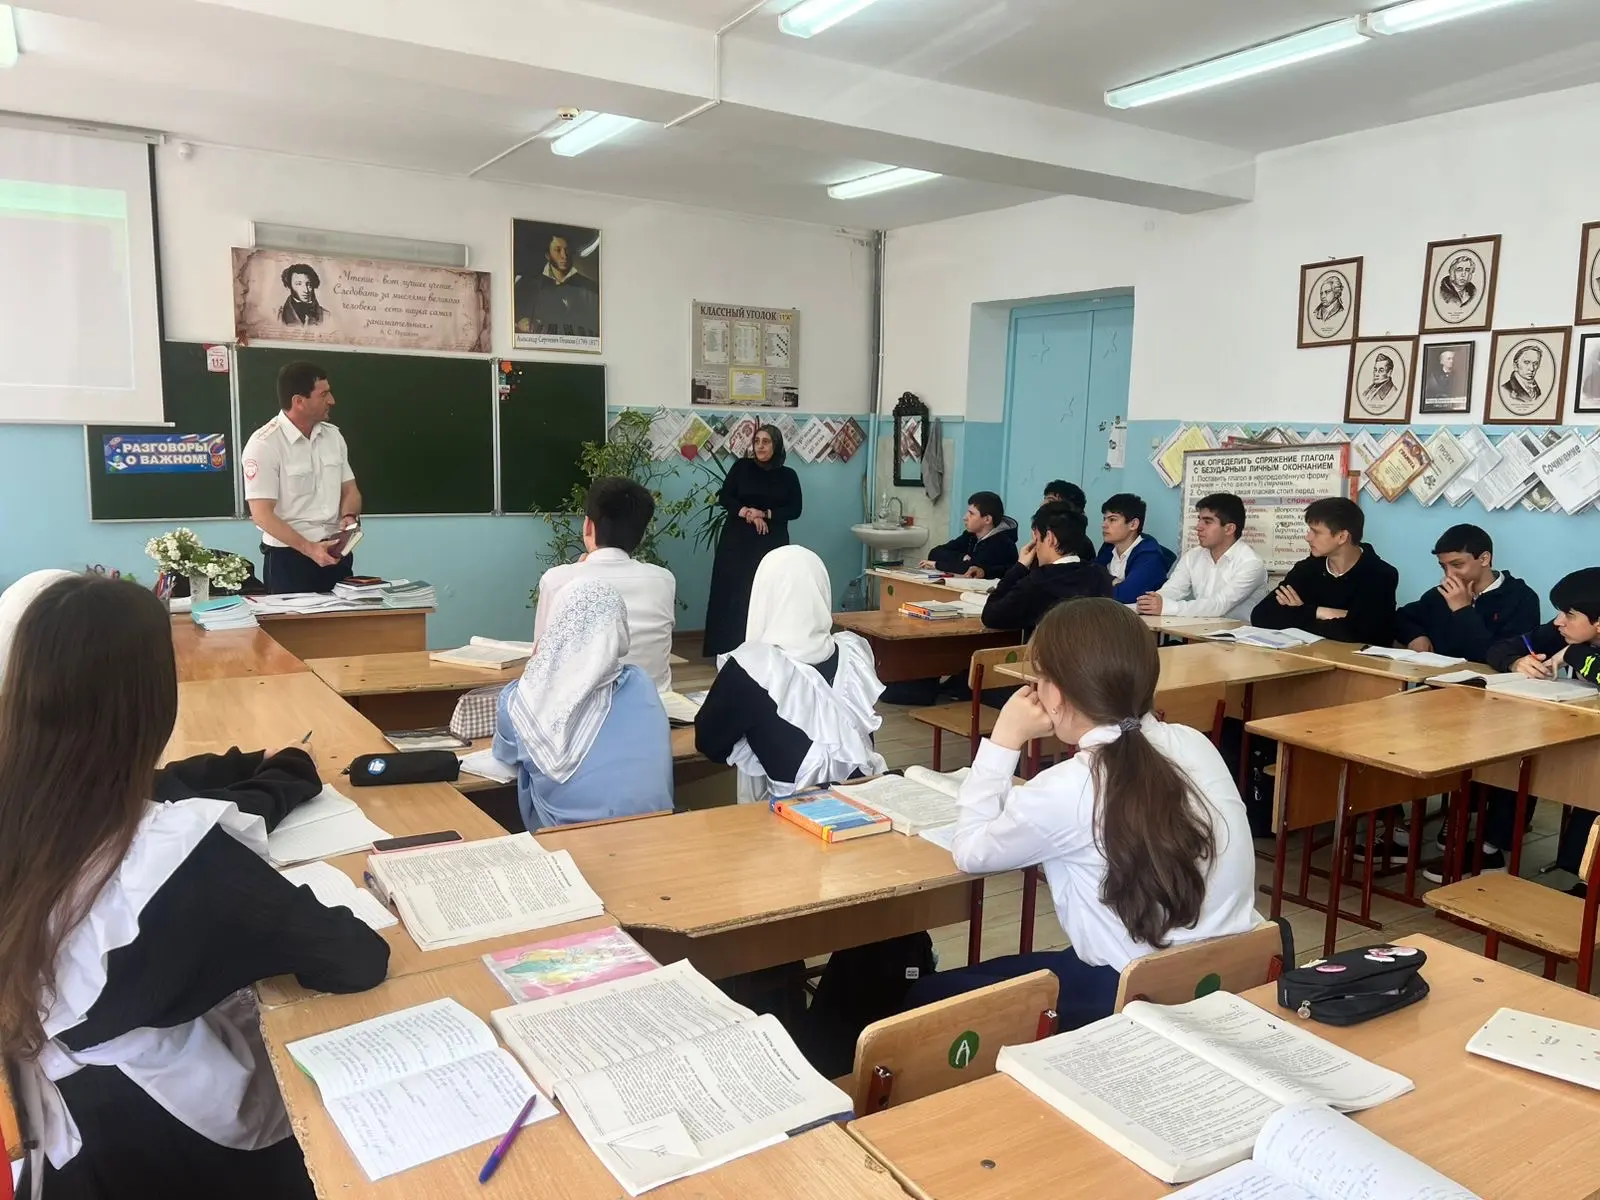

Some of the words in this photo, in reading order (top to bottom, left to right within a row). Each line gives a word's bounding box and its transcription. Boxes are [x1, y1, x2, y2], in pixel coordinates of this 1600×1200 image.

[333, 283, 380, 298] Следовать
[341, 300, 377, 312] человека
[700, 306, 745, 318] КЛАССНЫЙ
[745, 309, 777, 321] УГОЛОК
[211, 357, 225, 367] 112
[121, 442, 209, 454] РАЗГОВОРЫ
[1437, 443, 1455, 464] ПРОЕКТ
[125, 455, 137, 466] О
[139, 453, 208, 466] ВАЖНОМ!
[1192, 459, 1206, 467] КАК
[1207, 457, 1252, 467] ОПРЕДЕЛИТЬ
[1254, 454, 1298, 464] СПРЯЖЕНИЕ
[1300, 453, 1335, 462] ГЛАГОЛА
[1398, 447, 1416, 470] ГРАМОТА
[1541, 444, 1581, 475] Сочинение
[1193, 466, 1199, 474] С
[1201, 465, 1247, 475] БЕЗУДАРНЫМ
[1249, 464, 1279, 473] ЛИЧНЫМ
[1282, 462, 1333, 472] ОКОНЧАНИЕМ
[1197, 475, 1227, 483] Поставить
[1227, 474, 1247, 483] глагол
[1306, 471, 1329, 482] форму
